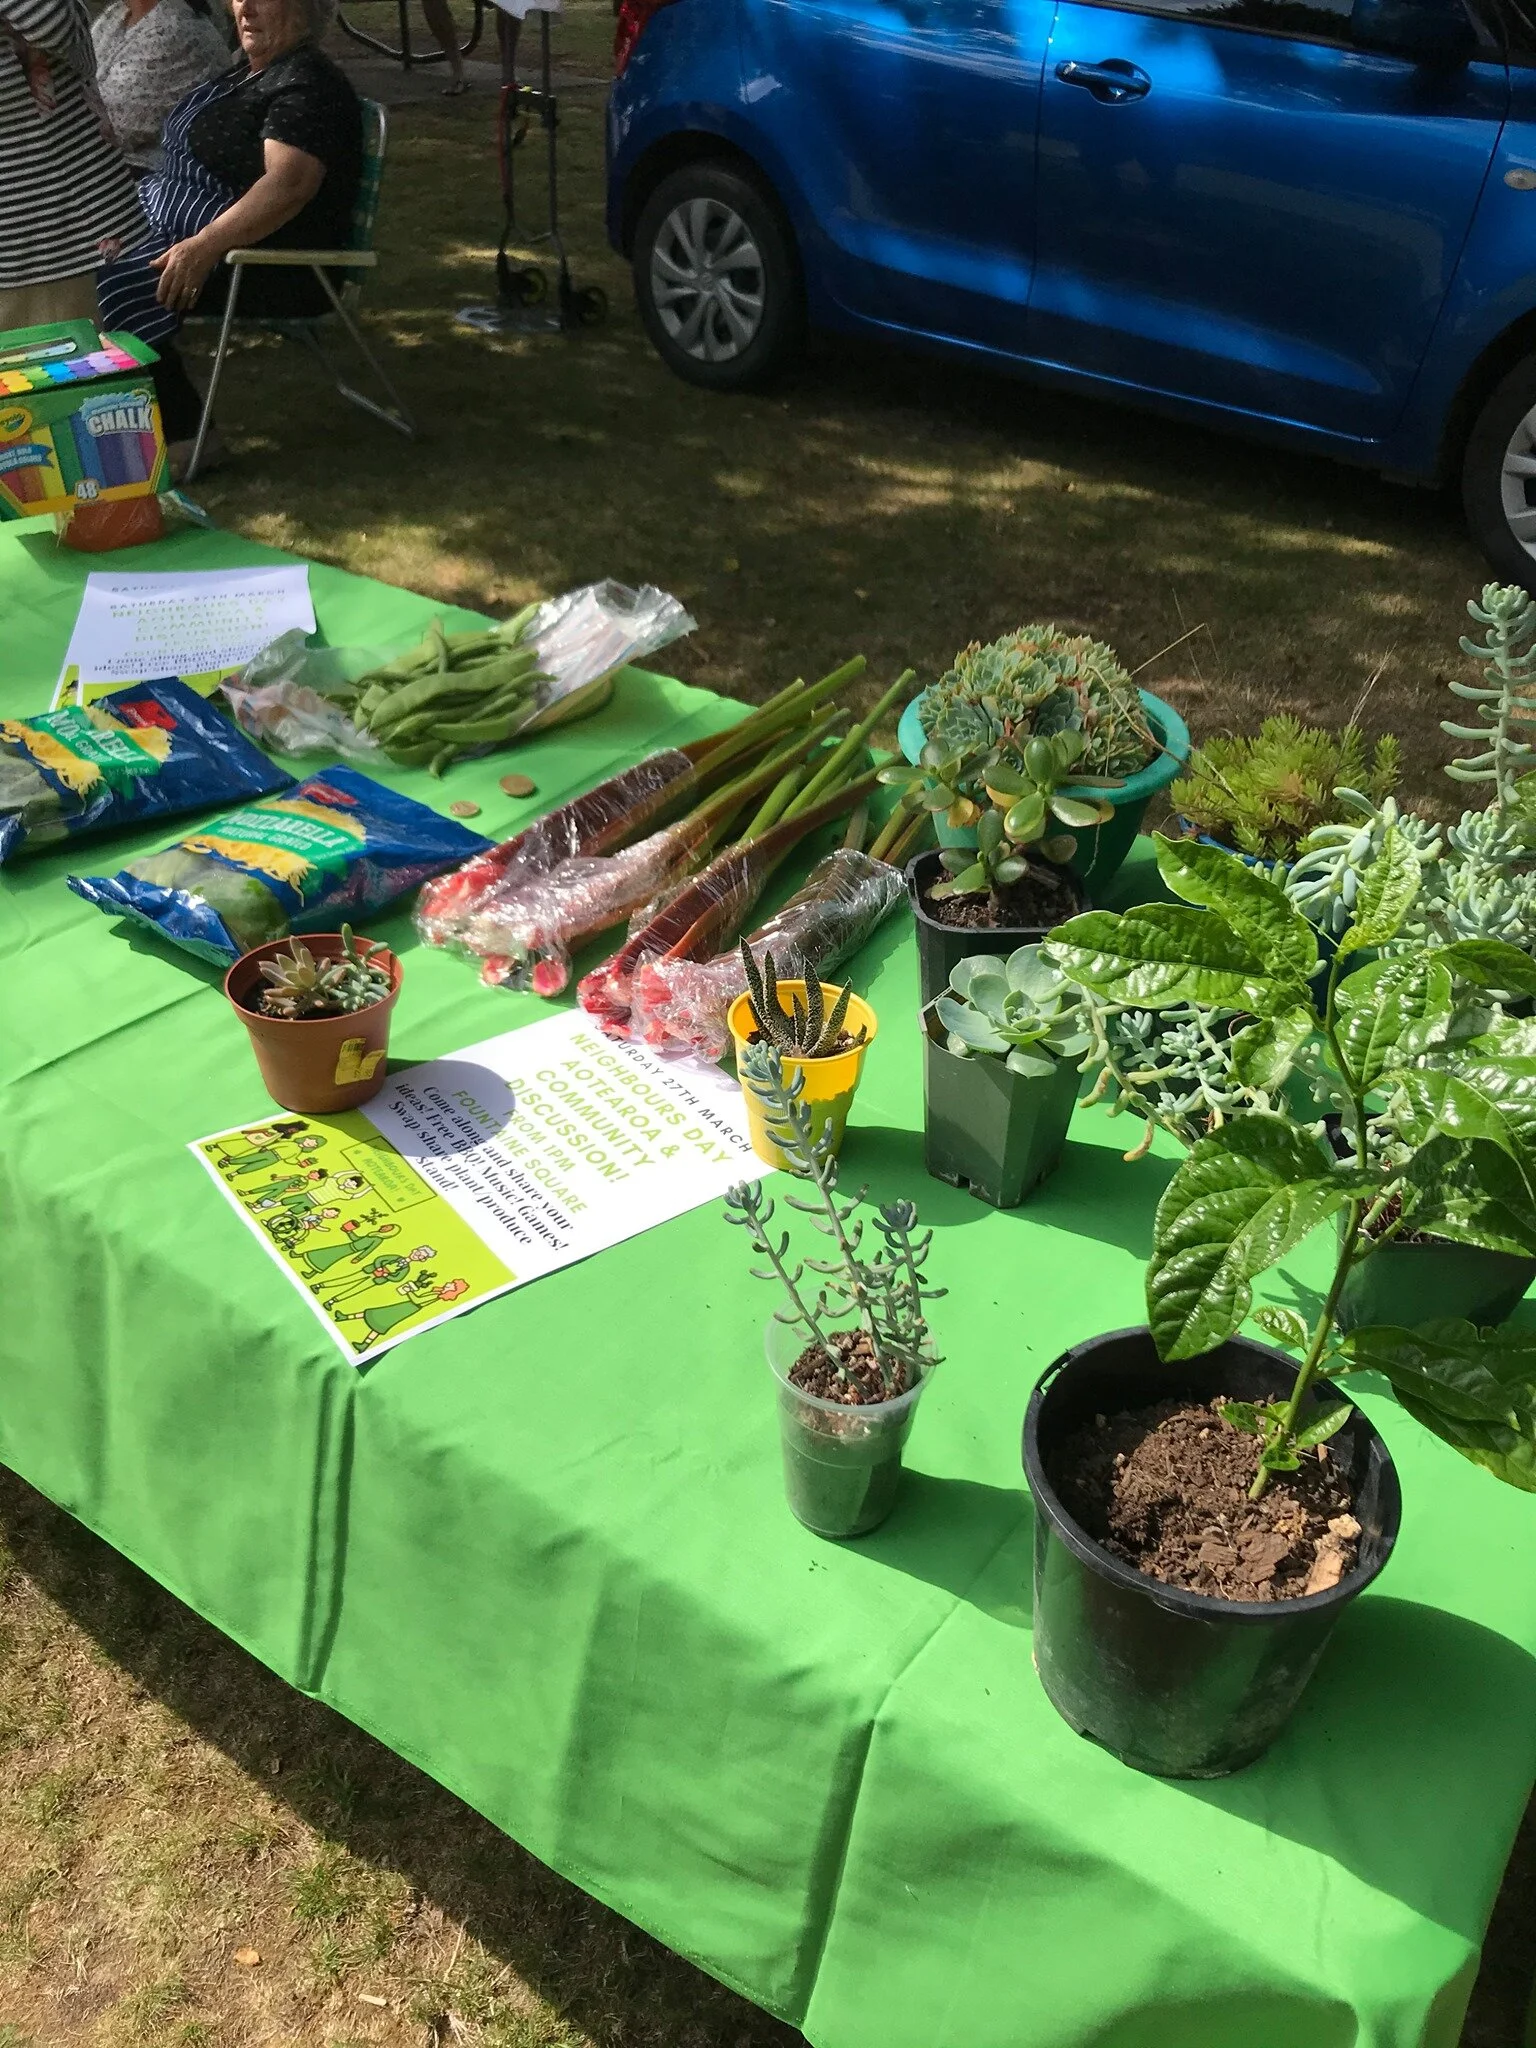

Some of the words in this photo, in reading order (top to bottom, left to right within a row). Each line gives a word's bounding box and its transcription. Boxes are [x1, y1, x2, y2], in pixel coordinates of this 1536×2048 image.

[88, 407, 151, 434] CHALK
[77, 483, 98, 498] 48
[503, 1109, 547, 1144] FROM
[543, 1145, 576, 1172] 1PM
[505, 1078, 630, 1183] DISCUSSION!
[536, 1070, 655, 1167] COMMUNITY
[560, 1060, 662, 1142] AOTEAROA
[660, 1144, 681, 1159] &
[570, 1033, 687, 1126] NEIGHBOURS
[683, 1127, 734, 1163] DAY
[662, 1078, 700, 1106] 27TH
[698, 1108, 752, 1153] MARCH
[389, 1101, 452, 1164] Swap/share
[445, 1164, 532, 1245] plant/produce
[395, 1084, 433, 1115] ideas!
[428, 1113, 455, 1140] Free
[451, 1139, 486, 1167] BBQ!
[480, 1166, 524, 1205] Music!
[517, 1205, 570, 1251] Games!
[416, 1156, 459, 1192] stand!
[423, 1086, 455, 1115] Come
[452, 1114, 487, 1146] along
[483, 1145, 512, 1168] and
[505, 1166, 542, 1202] share
[536, 1201, 574, 1230] your
[452, 1090, 529, 1158] FOUNTAINE
[525, 1158, 588, 1214] SQUARE
